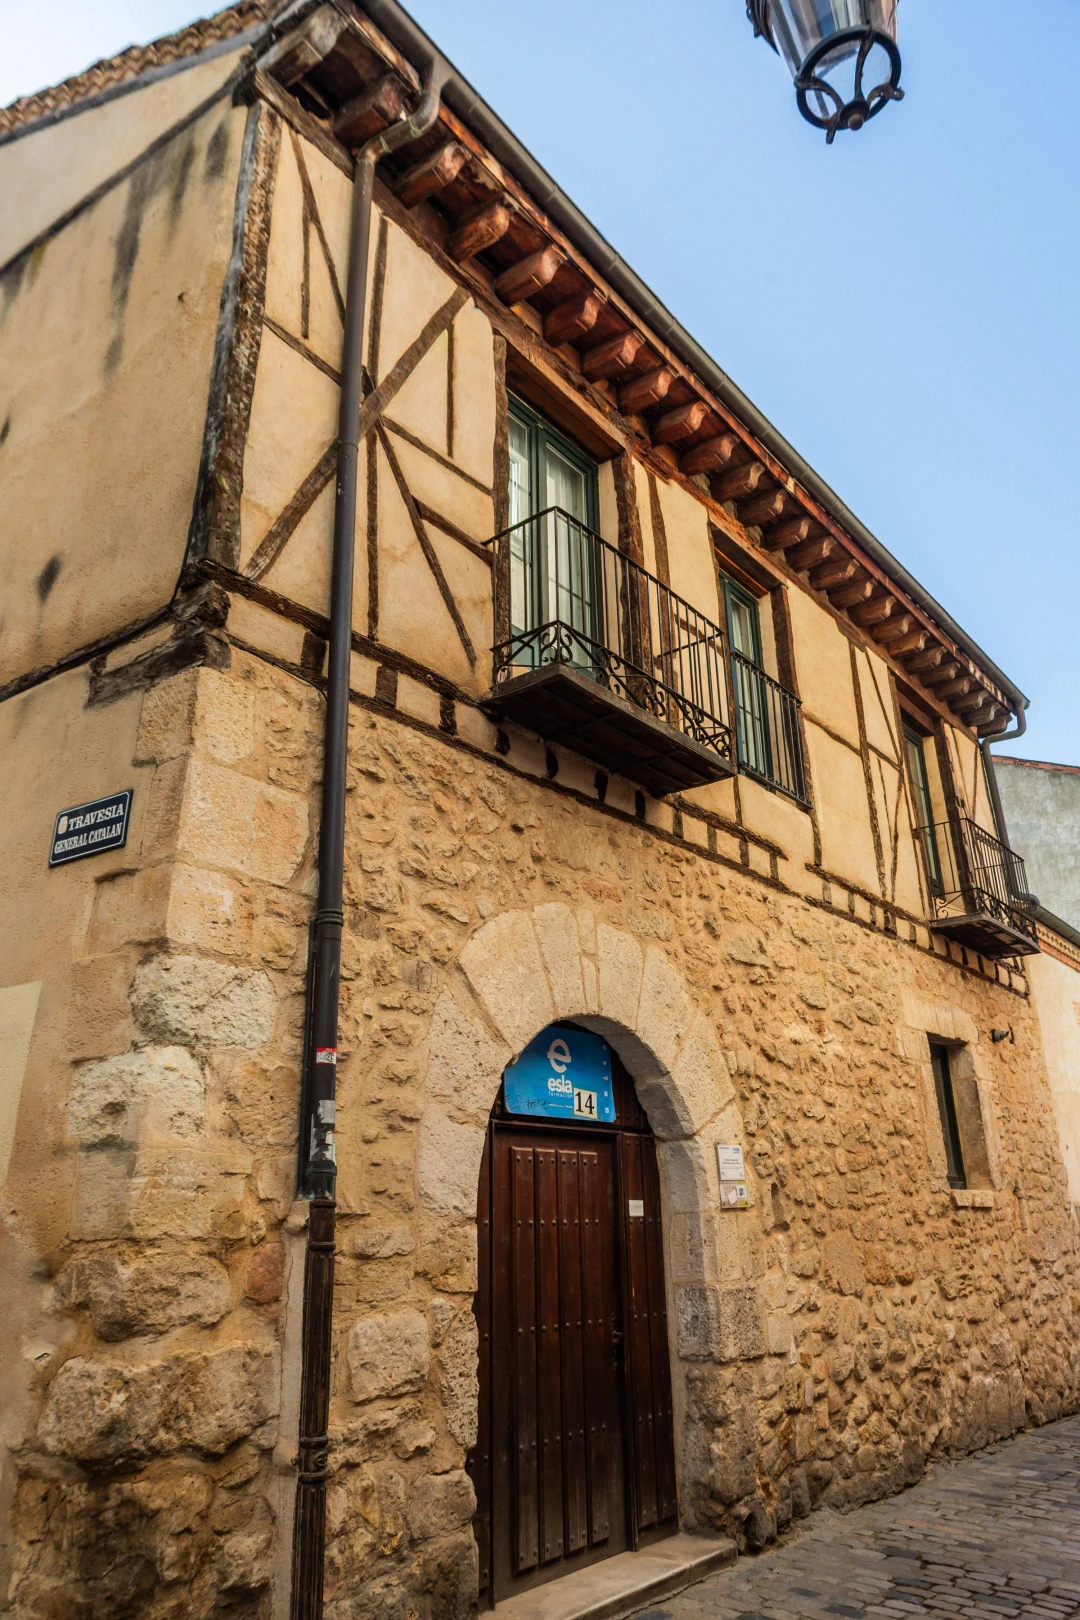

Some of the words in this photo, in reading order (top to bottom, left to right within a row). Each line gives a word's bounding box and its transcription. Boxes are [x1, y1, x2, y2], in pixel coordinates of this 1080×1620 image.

[68, 803, 124, 831] TRAVESIA
[54, 833, 88, 854] GENERAL
[88, 822, 123, 844] CATALAN
[548, 1075, 572, 1093] esla
[575, 1091, 595, 1115] 14
